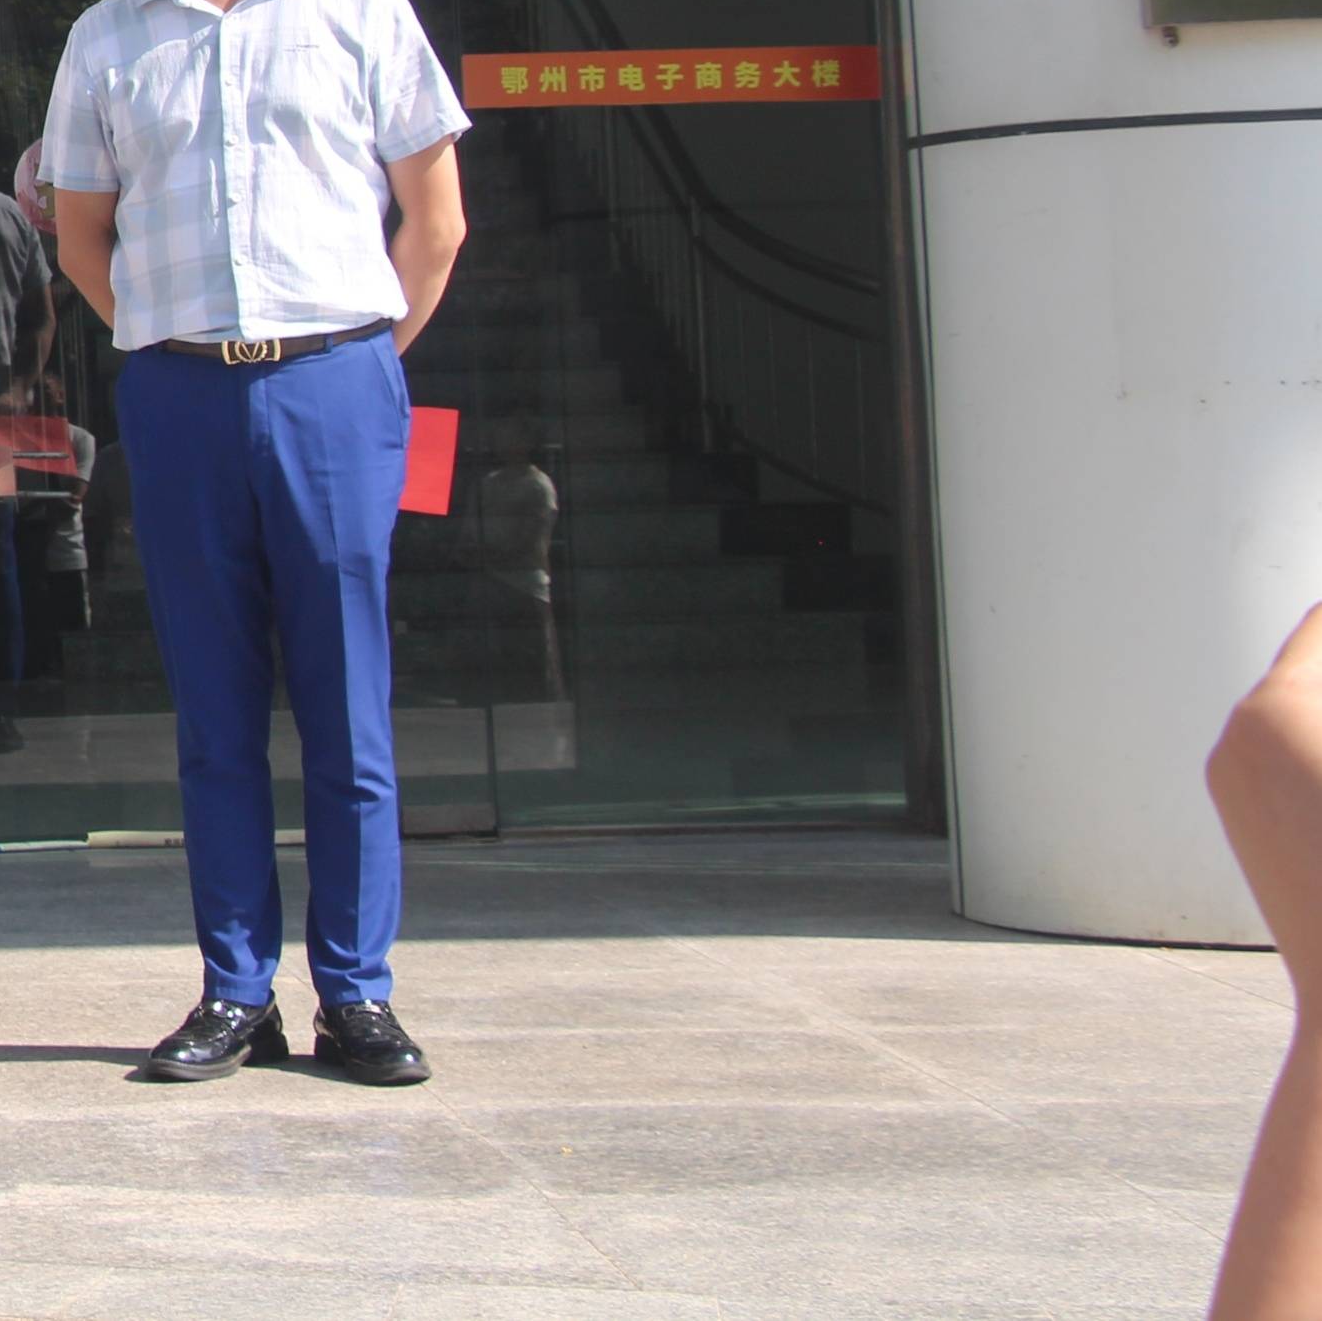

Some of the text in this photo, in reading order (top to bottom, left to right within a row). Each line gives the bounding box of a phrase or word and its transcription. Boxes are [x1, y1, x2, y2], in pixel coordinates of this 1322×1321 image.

[500, 59, 841, 94] 鄂州市电子商务大楼
